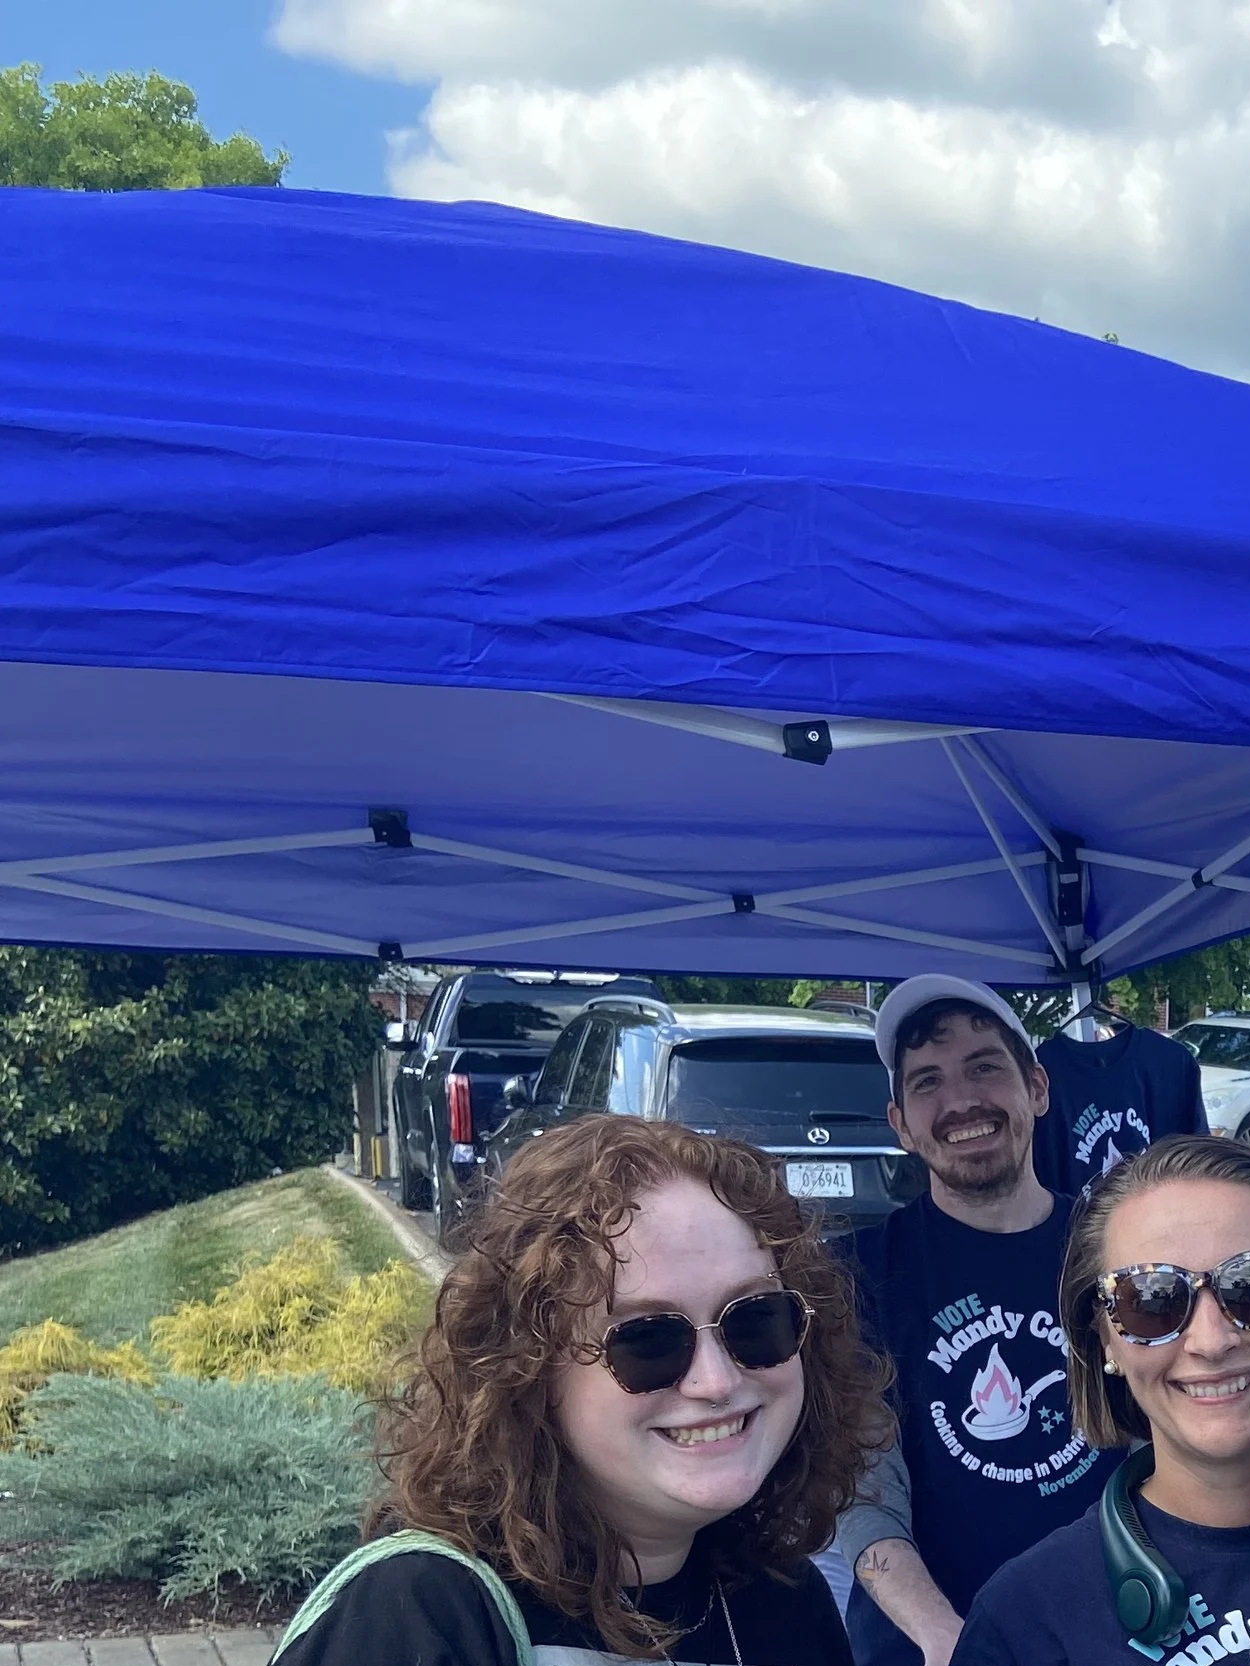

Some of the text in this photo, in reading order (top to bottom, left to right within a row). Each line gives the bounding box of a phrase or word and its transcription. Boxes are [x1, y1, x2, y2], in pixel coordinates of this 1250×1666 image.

[1072, 1102, 1100, 1137] VOTE
[1076, 1107, 1150, 1165] Mandy Coo
[927, 1304, 1025, 1374] Mandy
[932, 1293, 986, 1334] VOTE
[930, 1400, 964, 1457] Cooking
[961, 1451, 981, 1471] up
[982, 1462, 1034, 1484] change
[1034, 1462, 1050, 1478] in
